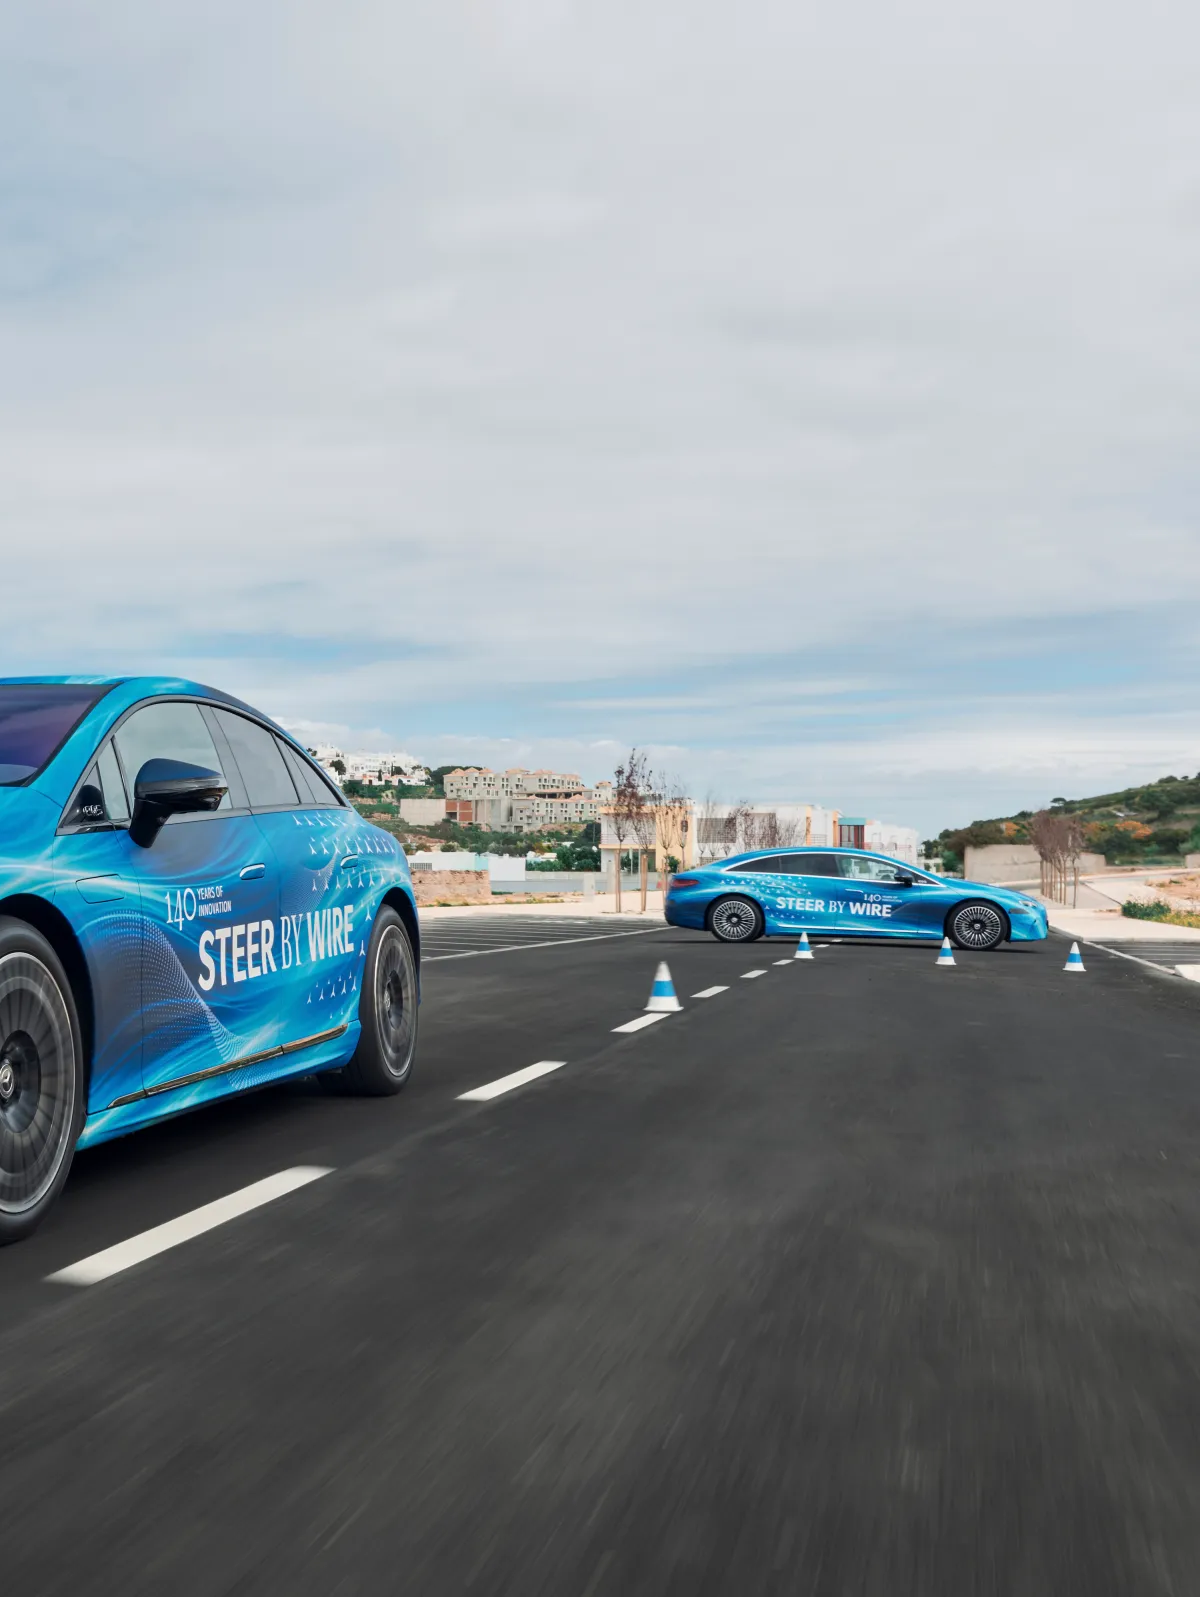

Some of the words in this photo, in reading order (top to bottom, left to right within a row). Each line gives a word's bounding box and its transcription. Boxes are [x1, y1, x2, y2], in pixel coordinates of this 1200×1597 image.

[196, 886, 216, 901] YEARS
[215, 885, 224, 898] OF
[863, 893, 882, 903] 140
[164, 887, 197, 931] 140
[198, 900, 232, 917] INNOVATION
[775, 896, 825, 912] STEER
[829, 901, 847, 914] BY
[849, 901, 892, 917] WIRE
[198, 919, 277, 991] STEER
[280, 913, 304, 970] BY
[307, 904, 355, 962] WIRE
